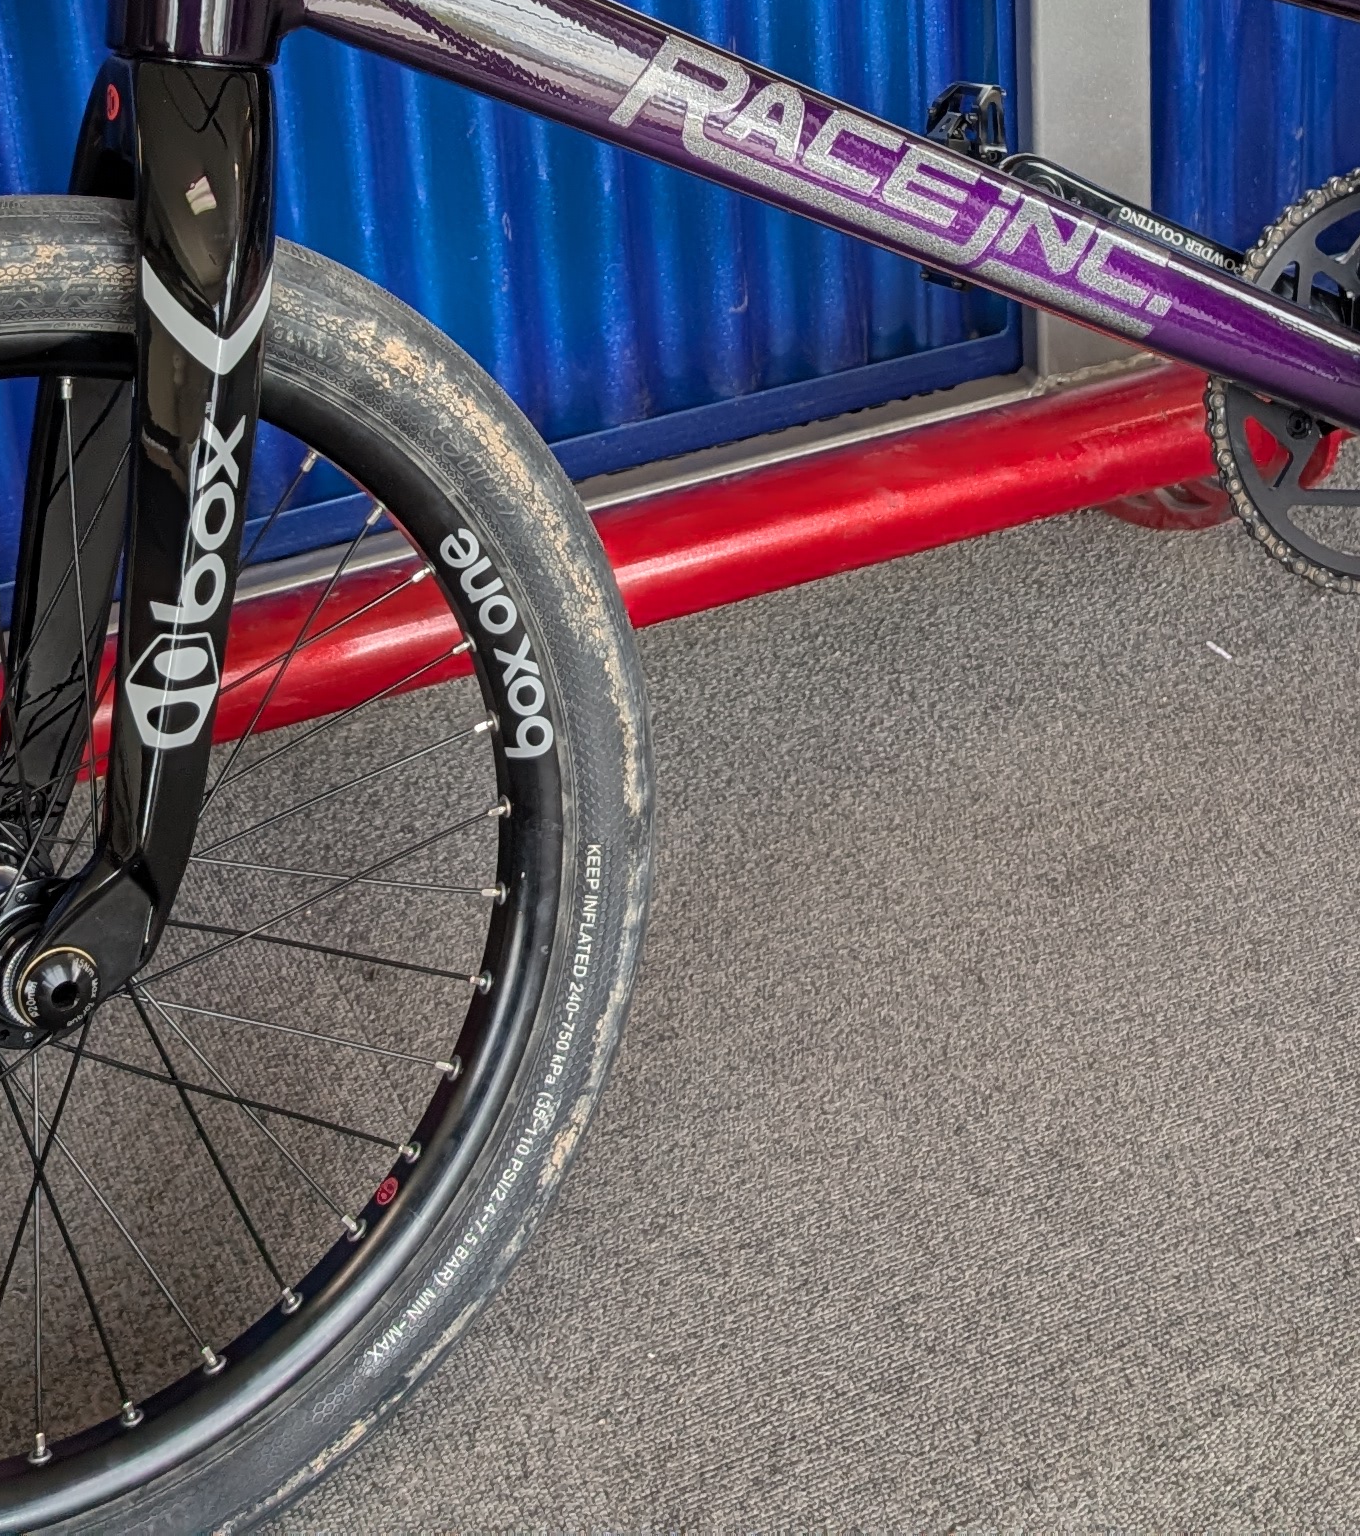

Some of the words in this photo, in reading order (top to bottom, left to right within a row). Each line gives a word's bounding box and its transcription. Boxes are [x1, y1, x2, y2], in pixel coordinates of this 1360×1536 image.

[608, 35, 982, 232] RACE
[1118, 206, 1184, 246] COATING
[150, 415, 247, 625] box
[439, 526, 517, 635] one
[492, 632, 555, 759] box
[585, 844, 602, 888] KEEP
[570, 891, 600, 978] INFLATED
[67, 1002, 95, 1027] Torque
[554, 983, 585, 1051] 240-750
[544, 1052, 566, 1085] kPa
[514, 1091, 554, 1160] (35-110
[464, 1153, 526, 1246] PSI/2.4-7.5
[437, 1244, 473, 1289] BAR)
